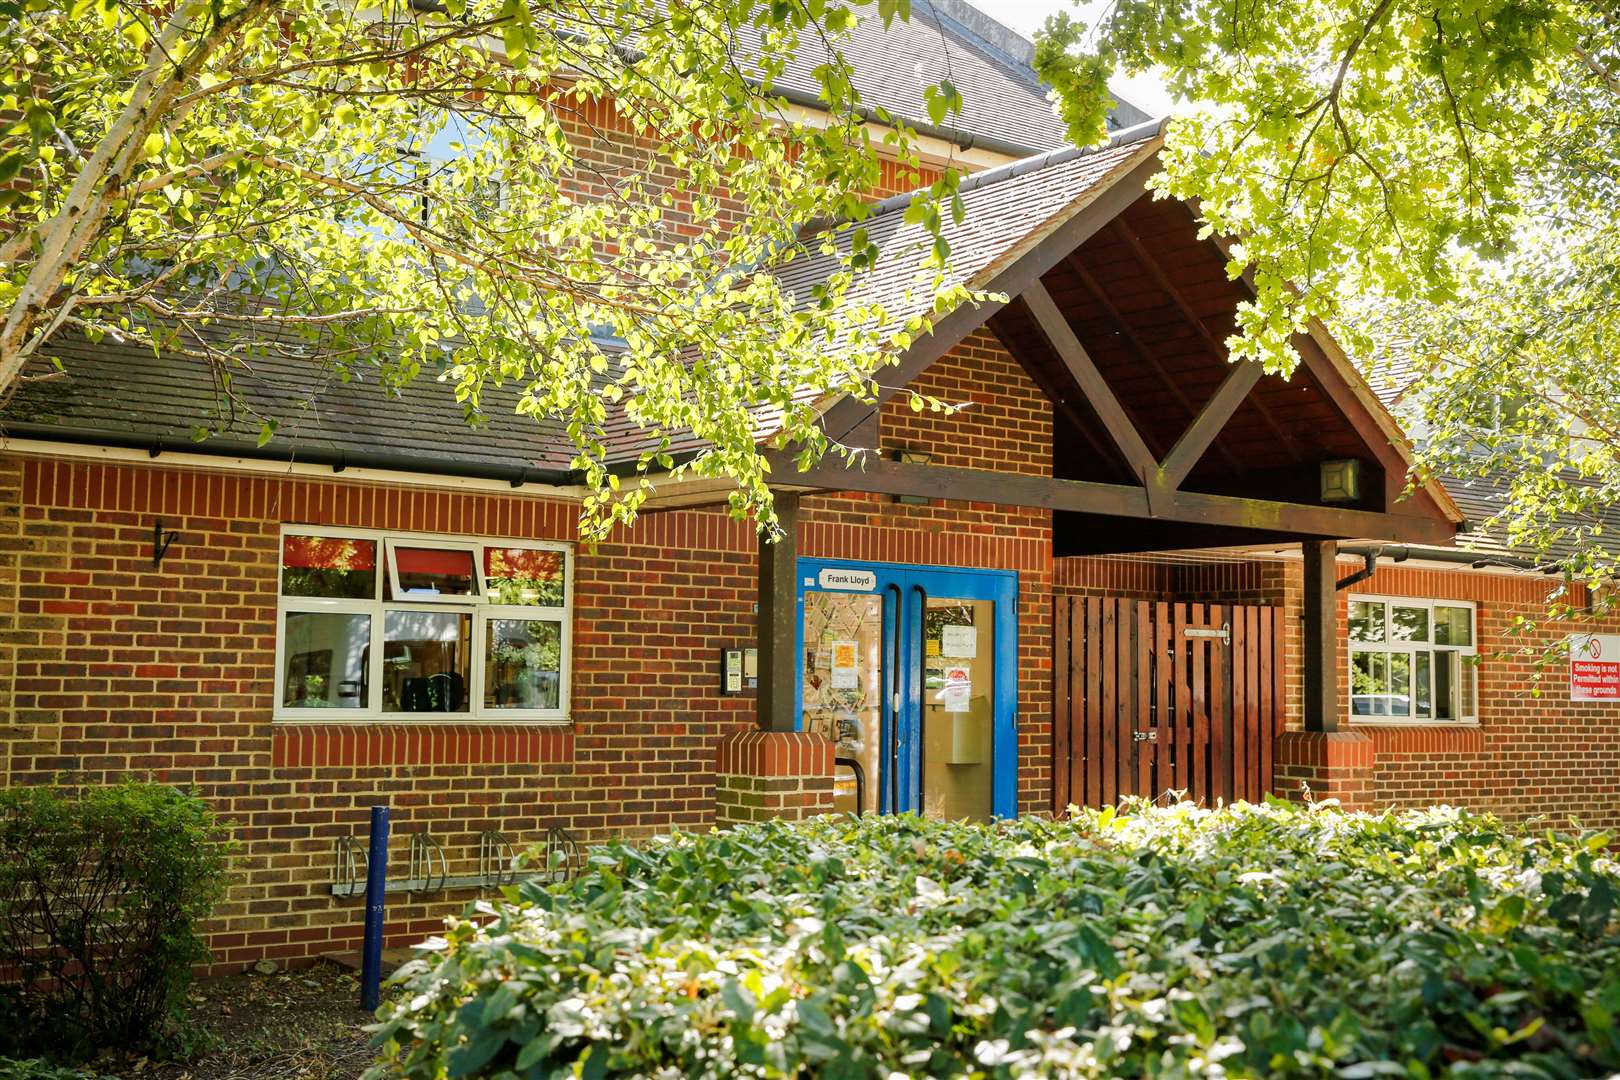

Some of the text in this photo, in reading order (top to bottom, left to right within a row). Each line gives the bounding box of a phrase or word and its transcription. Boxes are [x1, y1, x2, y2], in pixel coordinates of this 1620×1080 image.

[827, 574, 870, 586] Frank Lloyd
[1575, 663, 1617, 674] Smoking is not
[1574, 674, 1620, 684] Permitted within
[1593, 686, 1616, 696] grounds
